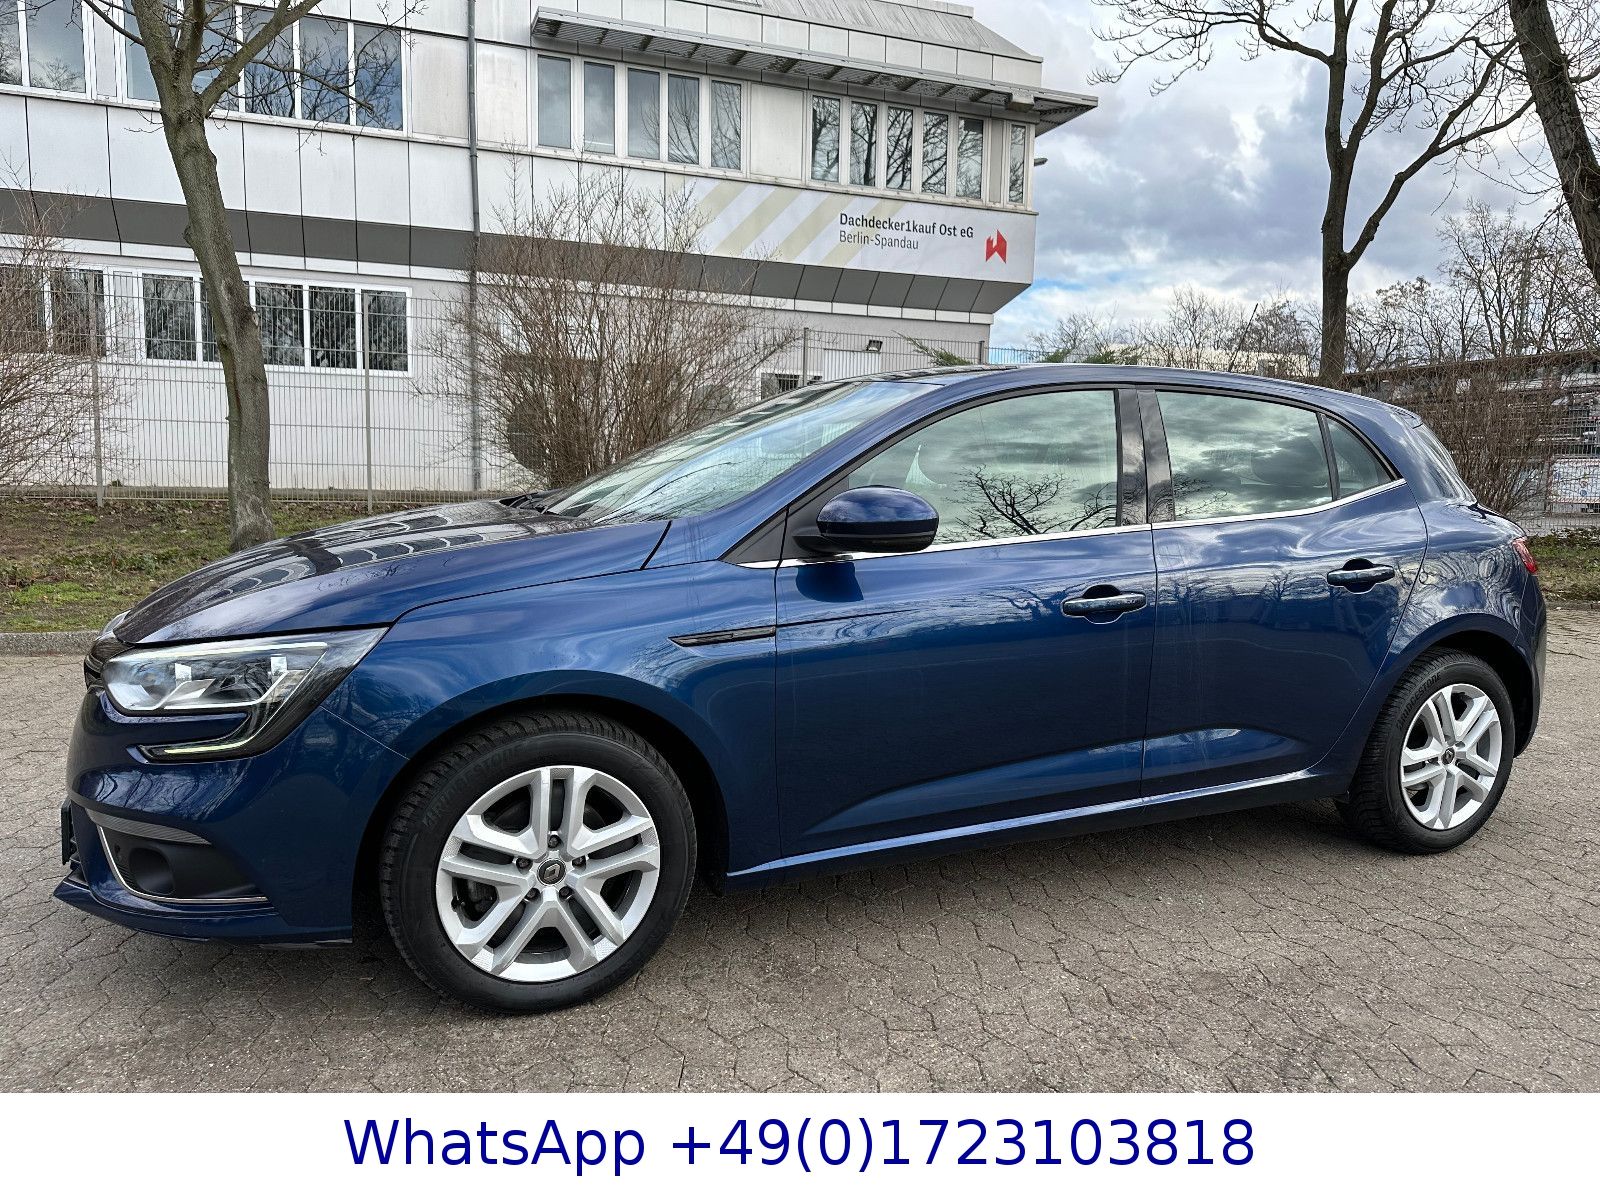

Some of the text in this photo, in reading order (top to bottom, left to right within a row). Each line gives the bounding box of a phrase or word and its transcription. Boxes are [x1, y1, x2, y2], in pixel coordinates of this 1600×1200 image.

[840, 213, 974, 239] Dachdecker1kauf Ost eG
[839, 230, 919, 250] Berlin-Spandau
